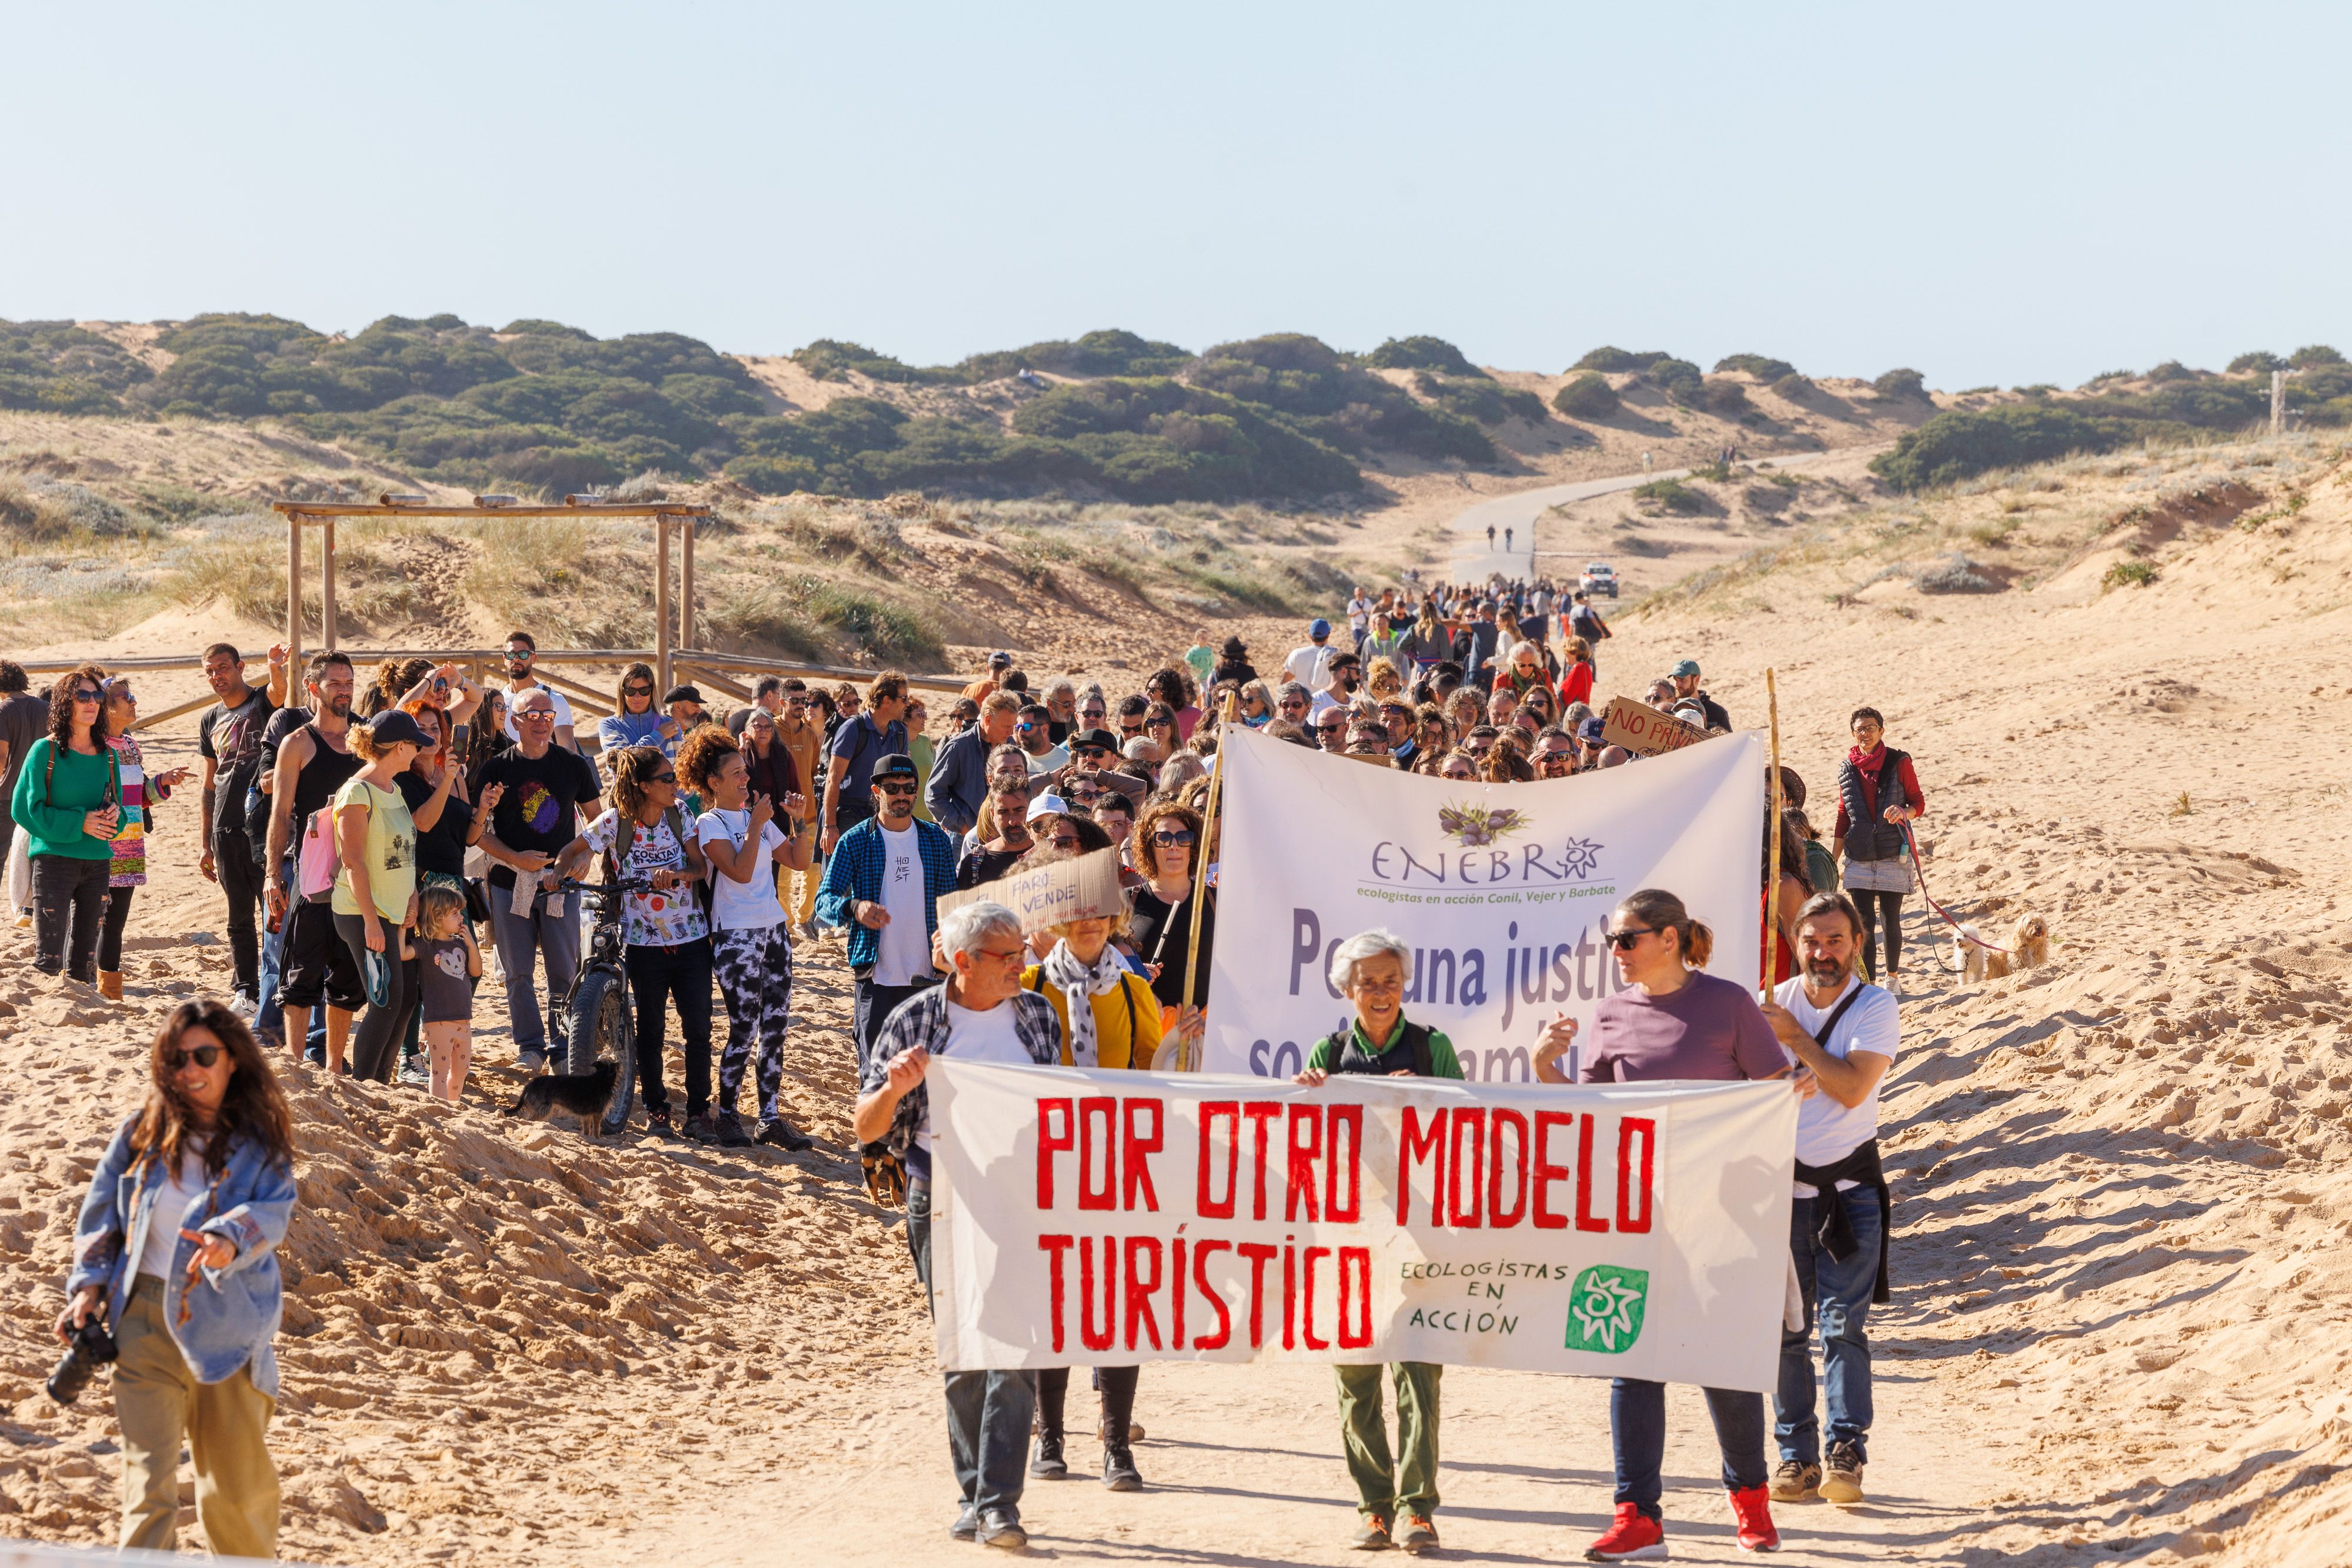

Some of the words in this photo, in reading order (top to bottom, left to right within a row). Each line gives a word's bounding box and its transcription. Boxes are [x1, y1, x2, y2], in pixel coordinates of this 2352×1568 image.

[1611, 707, 1645, 734] NO
[1023, 884, 1076, 913] VENDE
[1357, 887, 1422, 904] ecologistas
[1426, 895, 1440, 904] en
[1444, 894, 1484, 904] acción
[1488, 892, 1522, 904] Conil,
[1526, 891, 1556, 902] Vejer
[1559, 892, 1566, 902] y
[1569, 884, 1616, 898] Barbate
[1037, 1096, 1163, 1212] POR
[1197, 1101, 1364, 1223] OTRO
[1396, 1105, 1655, 1233] MODELO
[1467, 1282, 1505, 1300] EN
